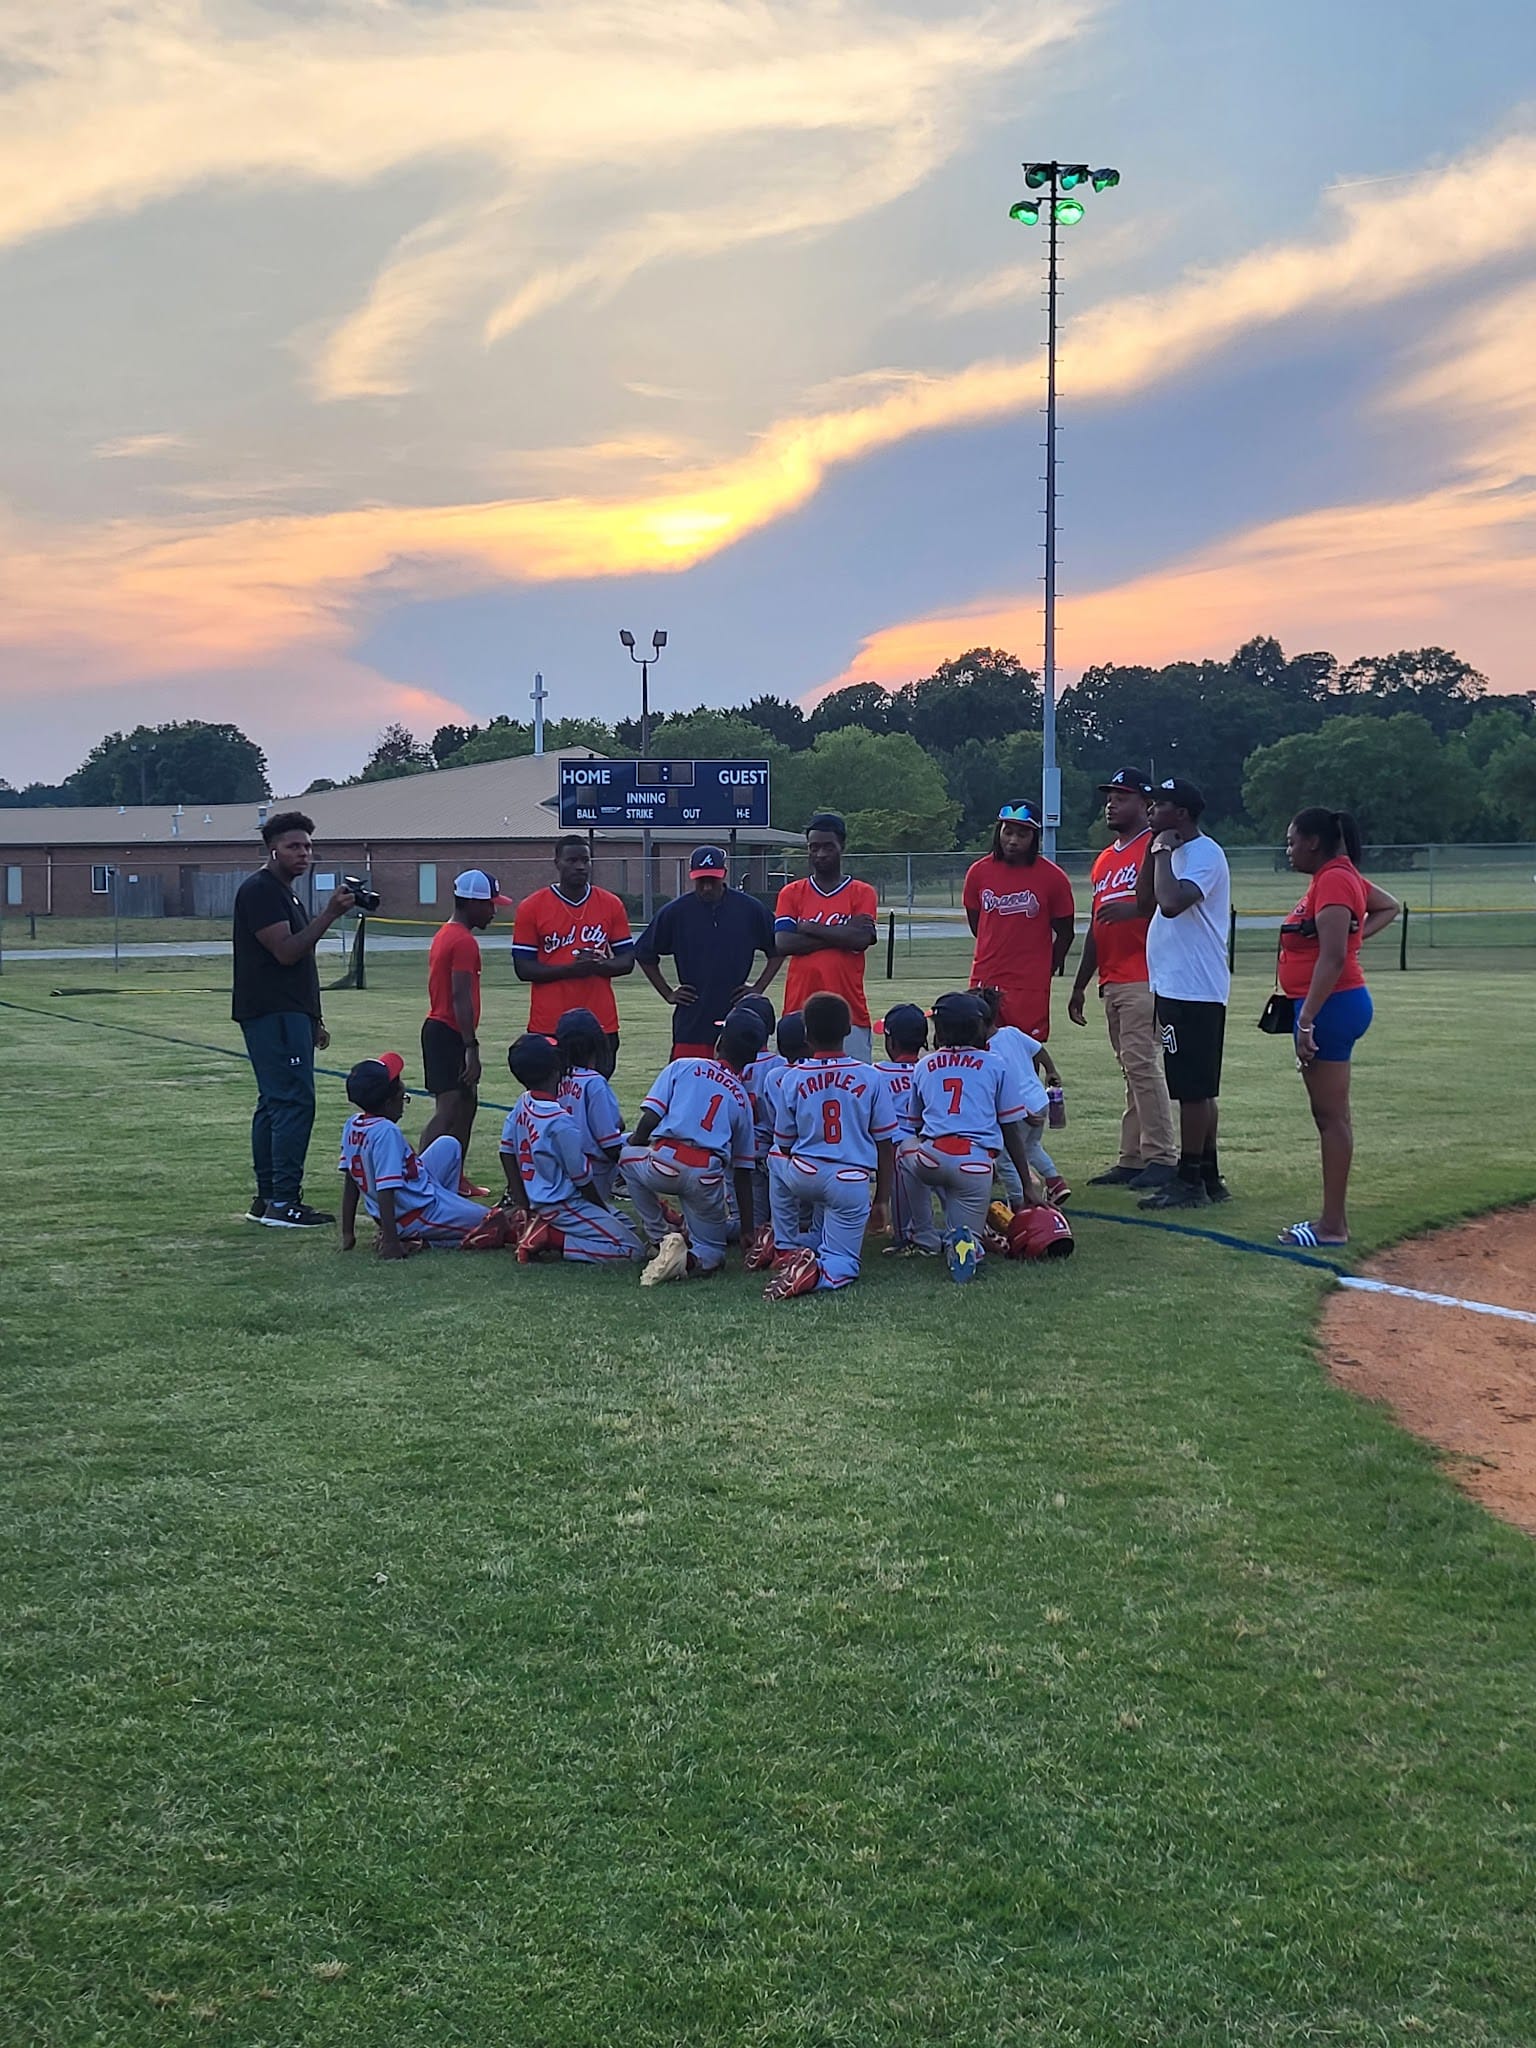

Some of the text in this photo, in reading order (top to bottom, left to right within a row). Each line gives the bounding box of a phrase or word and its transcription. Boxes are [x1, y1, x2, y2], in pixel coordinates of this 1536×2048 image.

[562, 769, 611, 785] HOME
[718, 770, 768, 785] GUEST
[626, 792, 666, 804] INNING
[576, 808, 597, 819] BALL
[626, 808, 654, 819] STRIKE
[682, 808, 701, 819] OUT
[1111, 862, 1137, 889] City
[544, 924, 607, 953] Stud City
[927, 1054, 984, 1073] GUNNA
[799, 1072, 856, 1100] TRIPLE
[851, 1084, 867, 1099] A
[943, 1078, 964, 1115] 7
[700, 1093, 724, 1132] 1
[822, 1099, 842, 1145] 8
[351, 1154, 369, 1192] 9
[519, 1139, 535, 1181] 2
